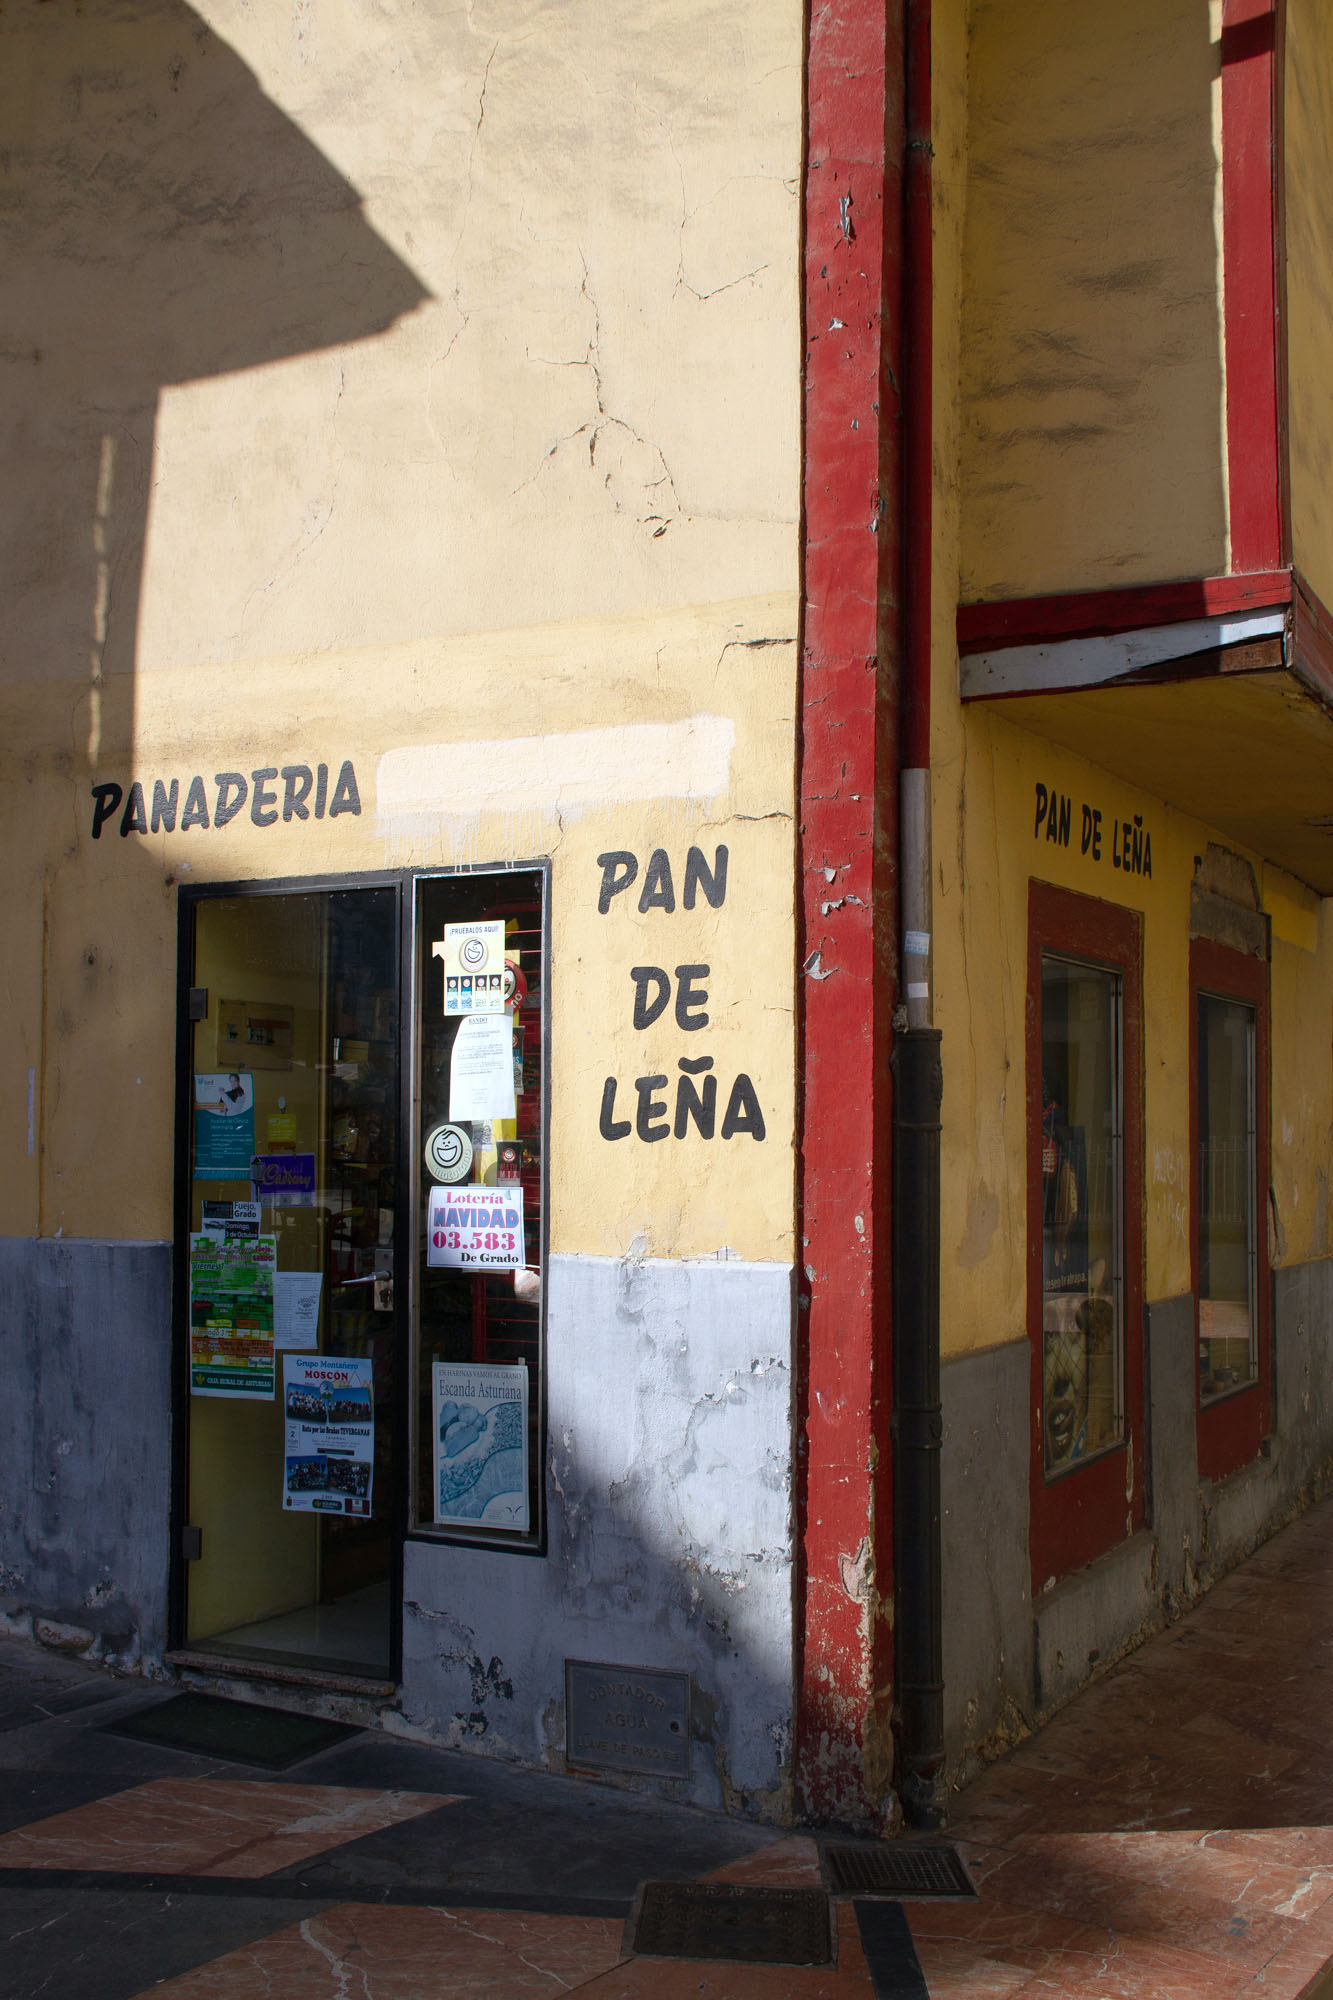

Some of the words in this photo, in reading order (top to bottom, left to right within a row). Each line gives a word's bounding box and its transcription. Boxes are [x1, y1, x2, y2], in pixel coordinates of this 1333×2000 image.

[91, 760, 362, 839] PANADERIA
[1035, 782, 1071, 848] PAN
[1081, 804, 1102, 862] DE
[1112, 814, 1152, 880] LEÑA
[597, 844, 729, 914] PAN
[630, 963, 710, 1031] DE
[600, 1055, 766, 1143] LEÑA
[446, 1191, 504, 1204] Lotería
[433, 1207, 519, 1228] NAVIDAD
[432, 1230, 516, 1250] 03.583
[192, 1262, 219, 1270] Viernes
[461, 1252, 478, 1263] De
[480, 1252, 519, 1264] Grado
[296, 1359, 319, 1369] Grupo
[320, 1360, 359, 1370] Montañero
[447, 1369, 473, 1378] HARINAS
[304, 1369, 349, 1381] MOSCÓN
[439, 1379, 476, 1397] Escanda
[478, 1381, 522, 1400] Asturiana
[587, 1682, 665, 1711] CONTADOR
[601, 1712, 649, 1728] AGUA
[615, 1742, 628, 1754] DE
[632, 1744, 661, 1758] PASO
